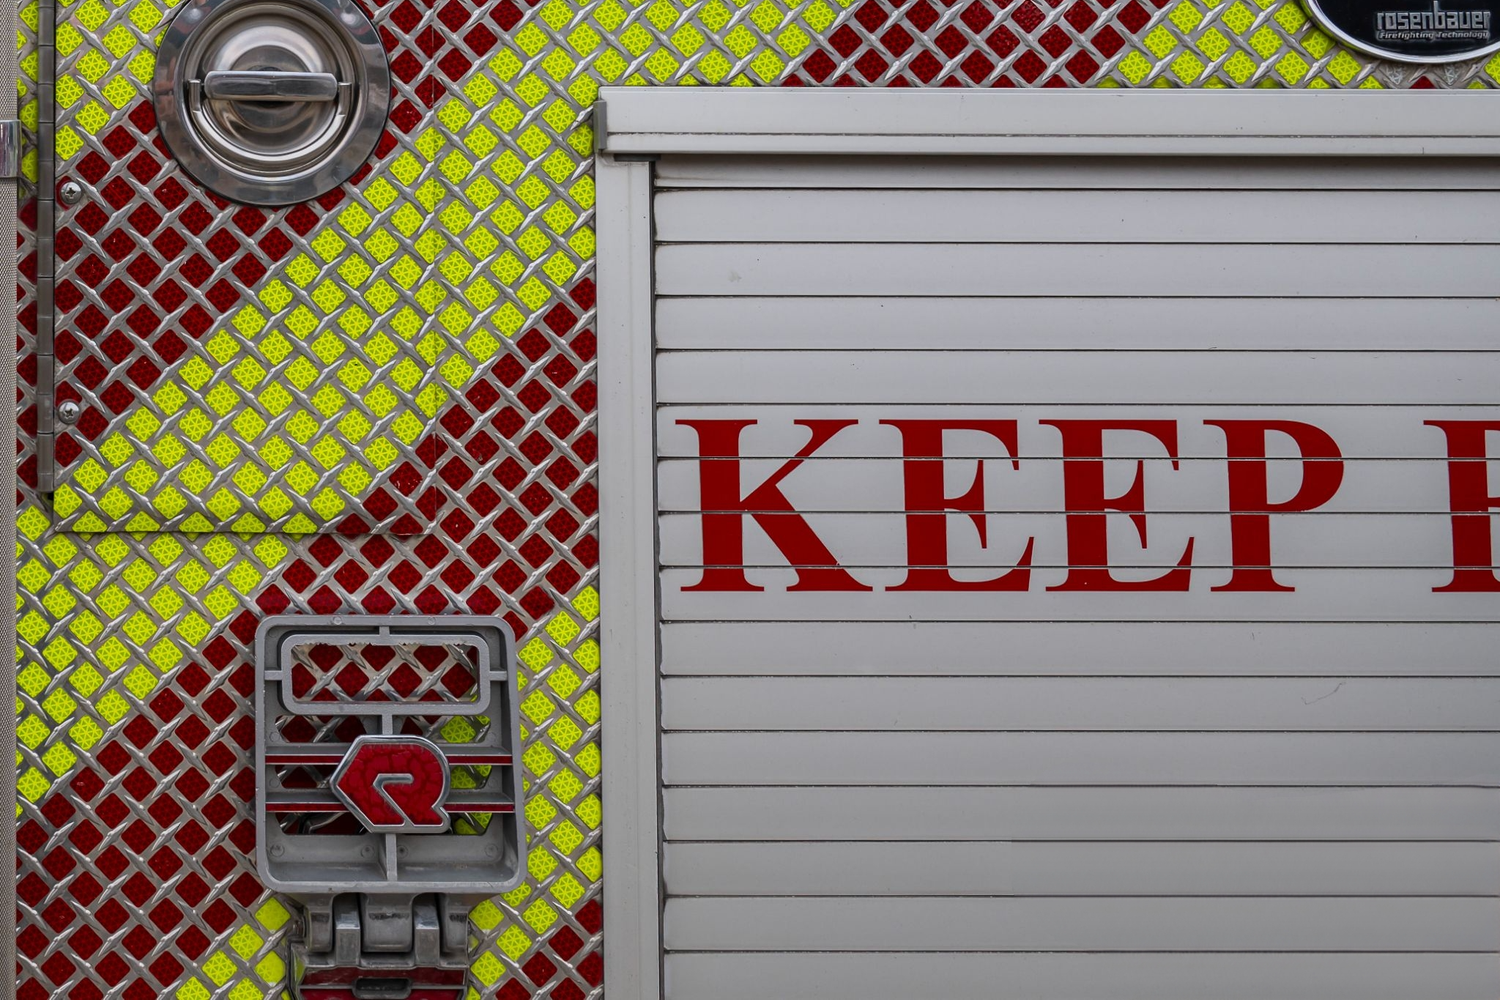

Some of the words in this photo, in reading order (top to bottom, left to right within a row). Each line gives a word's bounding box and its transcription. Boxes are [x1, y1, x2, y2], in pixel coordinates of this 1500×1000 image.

[1376, 0, 1491, 31] rosenbauer
[1437, 31, 1489, 40] Technology
[675, 419, 1344, 592] KEEP
